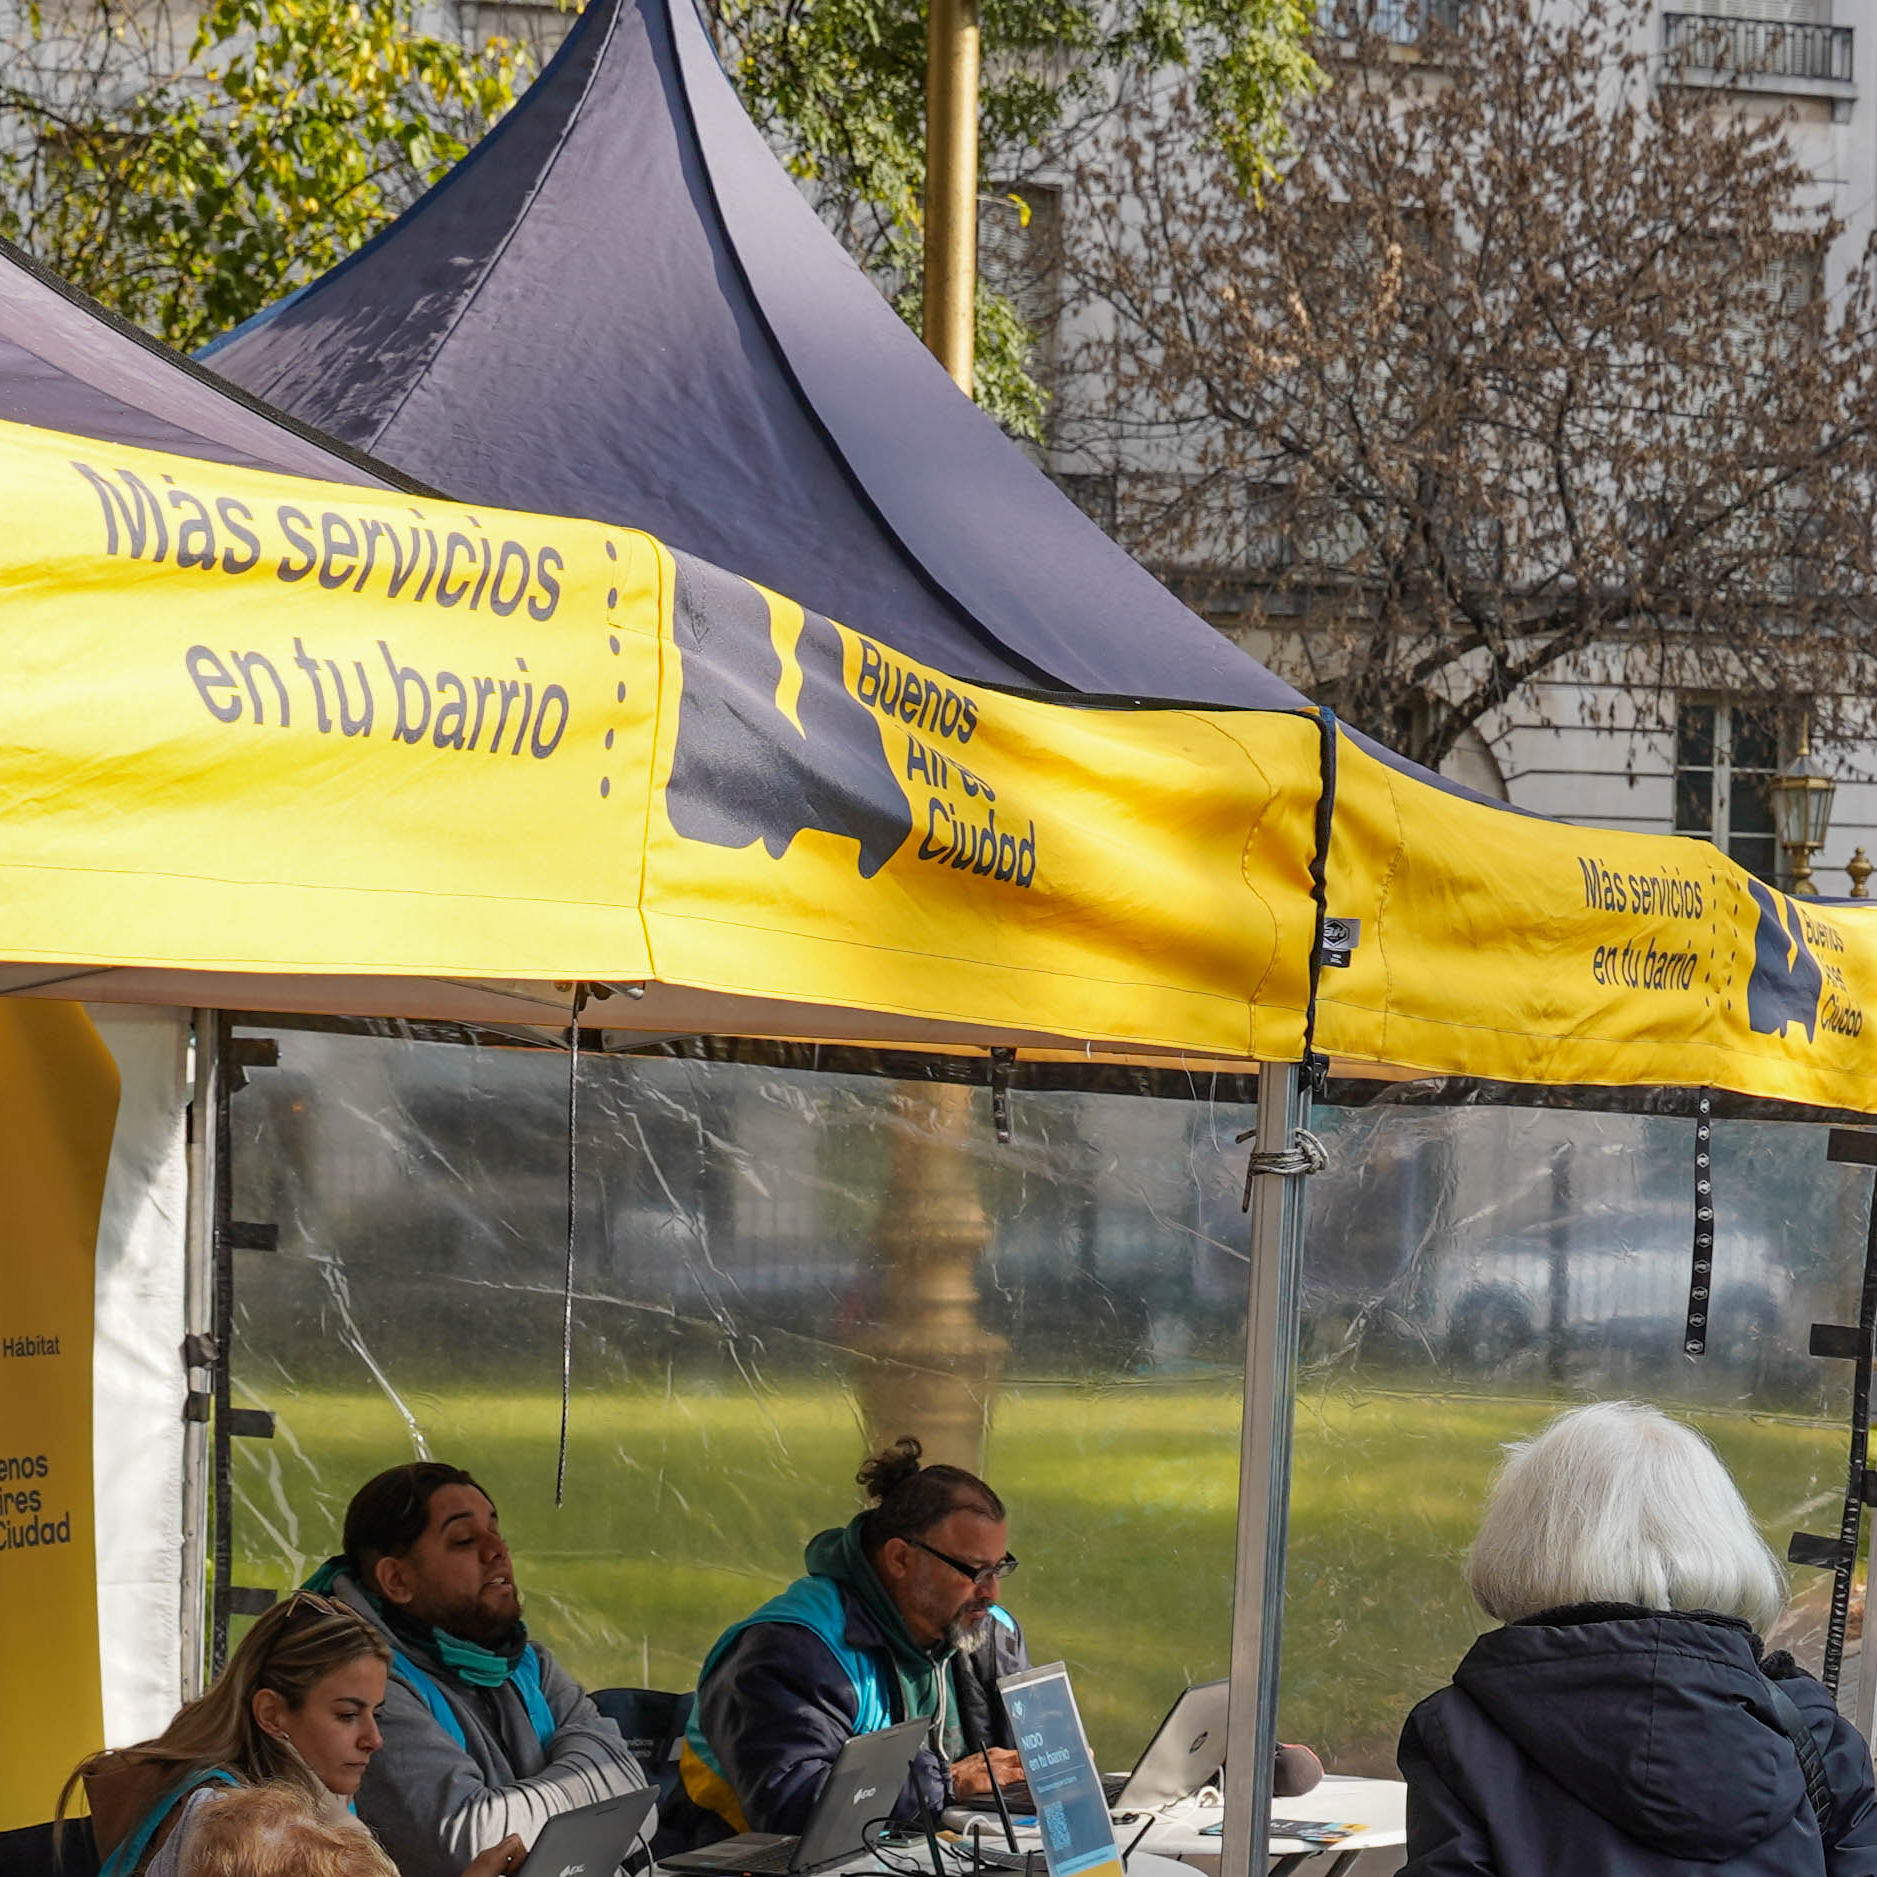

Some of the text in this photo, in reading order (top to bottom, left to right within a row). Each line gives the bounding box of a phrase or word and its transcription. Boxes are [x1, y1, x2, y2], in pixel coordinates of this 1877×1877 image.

[71, 462, 564, 622] Más servicios
[185, 637, 569, 761] en tu barrio
[857, 637, 978, 744] Buenos
[918, 797, 1036, 888] Ciudad
[1577, 857, 1703, 919] Más servicios
[1593, 937, 1698, 990] en tu barrio
[3, 1334, 61, 1359] Hábitat
